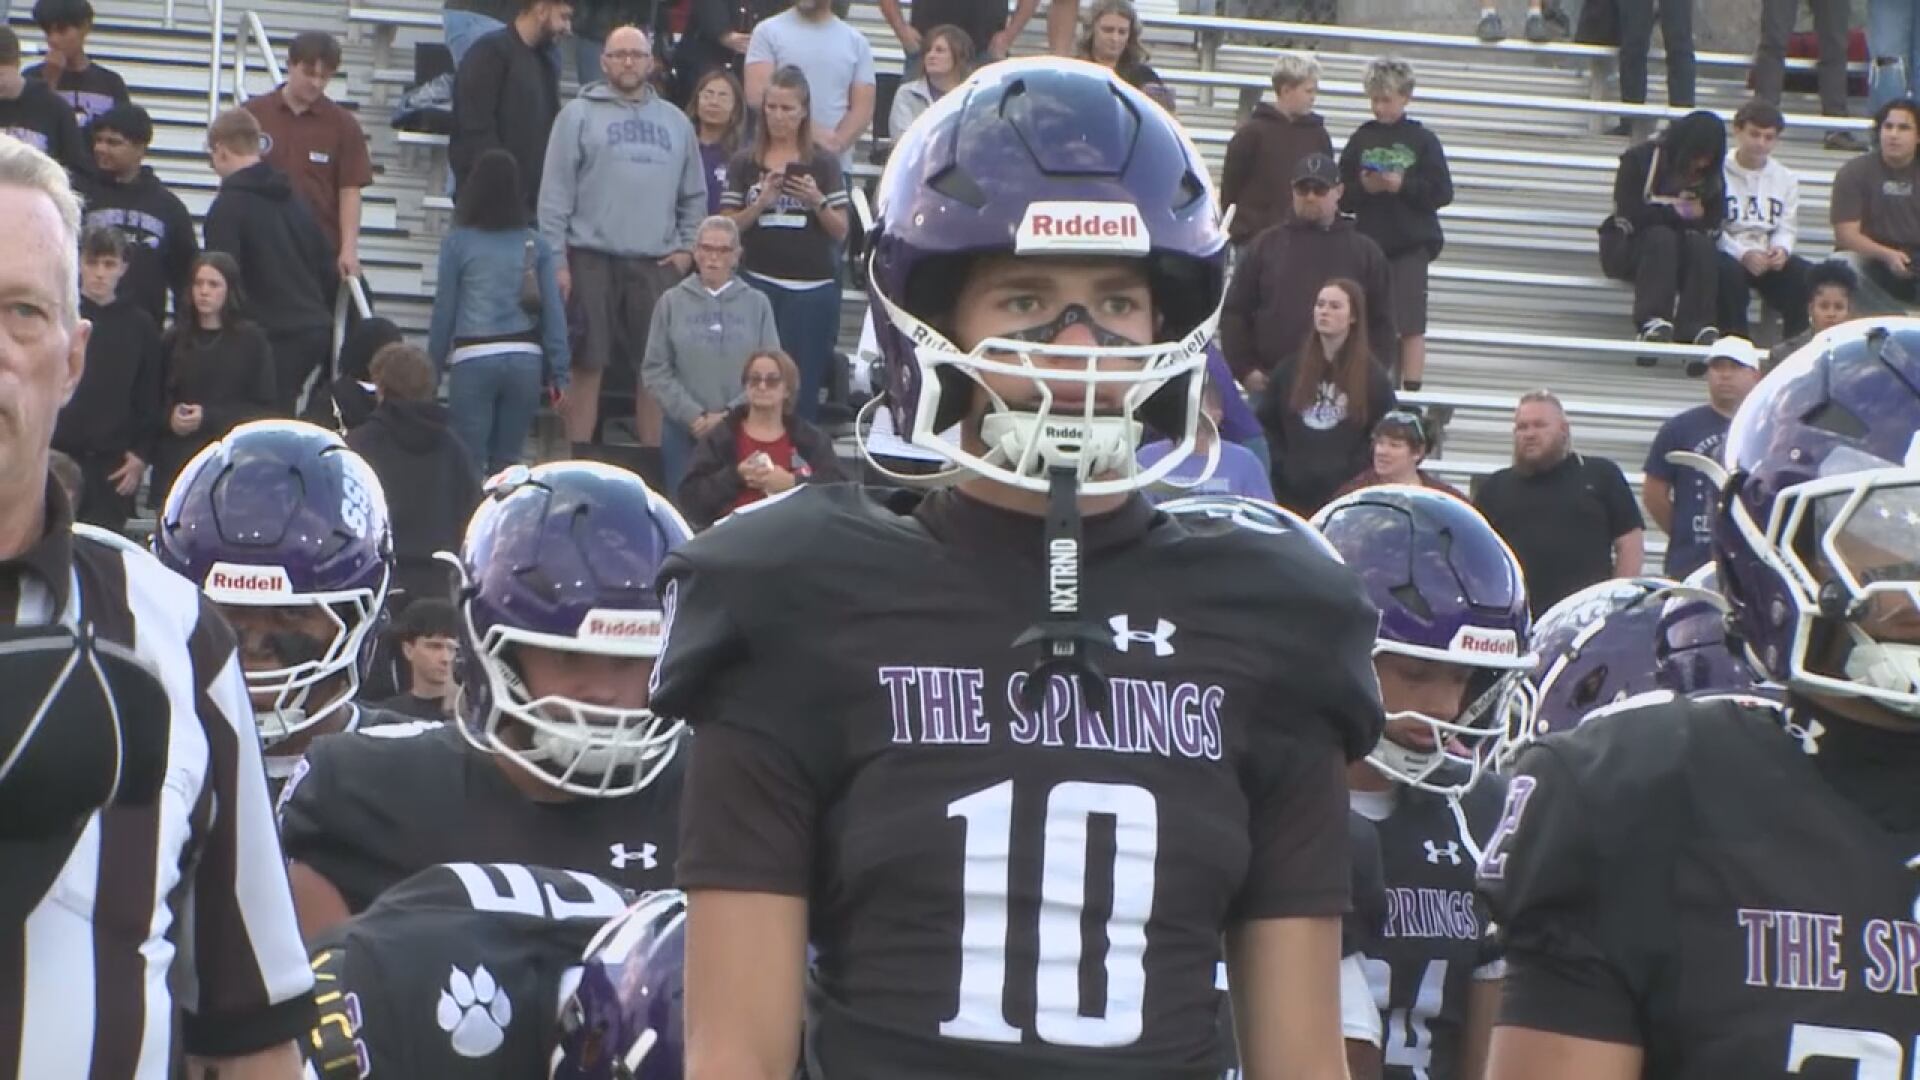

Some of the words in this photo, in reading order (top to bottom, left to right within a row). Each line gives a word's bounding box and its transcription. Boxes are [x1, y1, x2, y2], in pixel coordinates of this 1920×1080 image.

[1032, 213, 1137, 237] Riddell
[1725, 195, 1783, 224] GAP
[213, 572, 283, 592] Riddell
[1050, 539, 1078, 613] NXTRND
[1461, 634, 1515, 655] Riddell
[879, 666, 990, 744] THE
[939, 778, 1158, 1048] 10
[1737, 908, 1847, 991] THE
